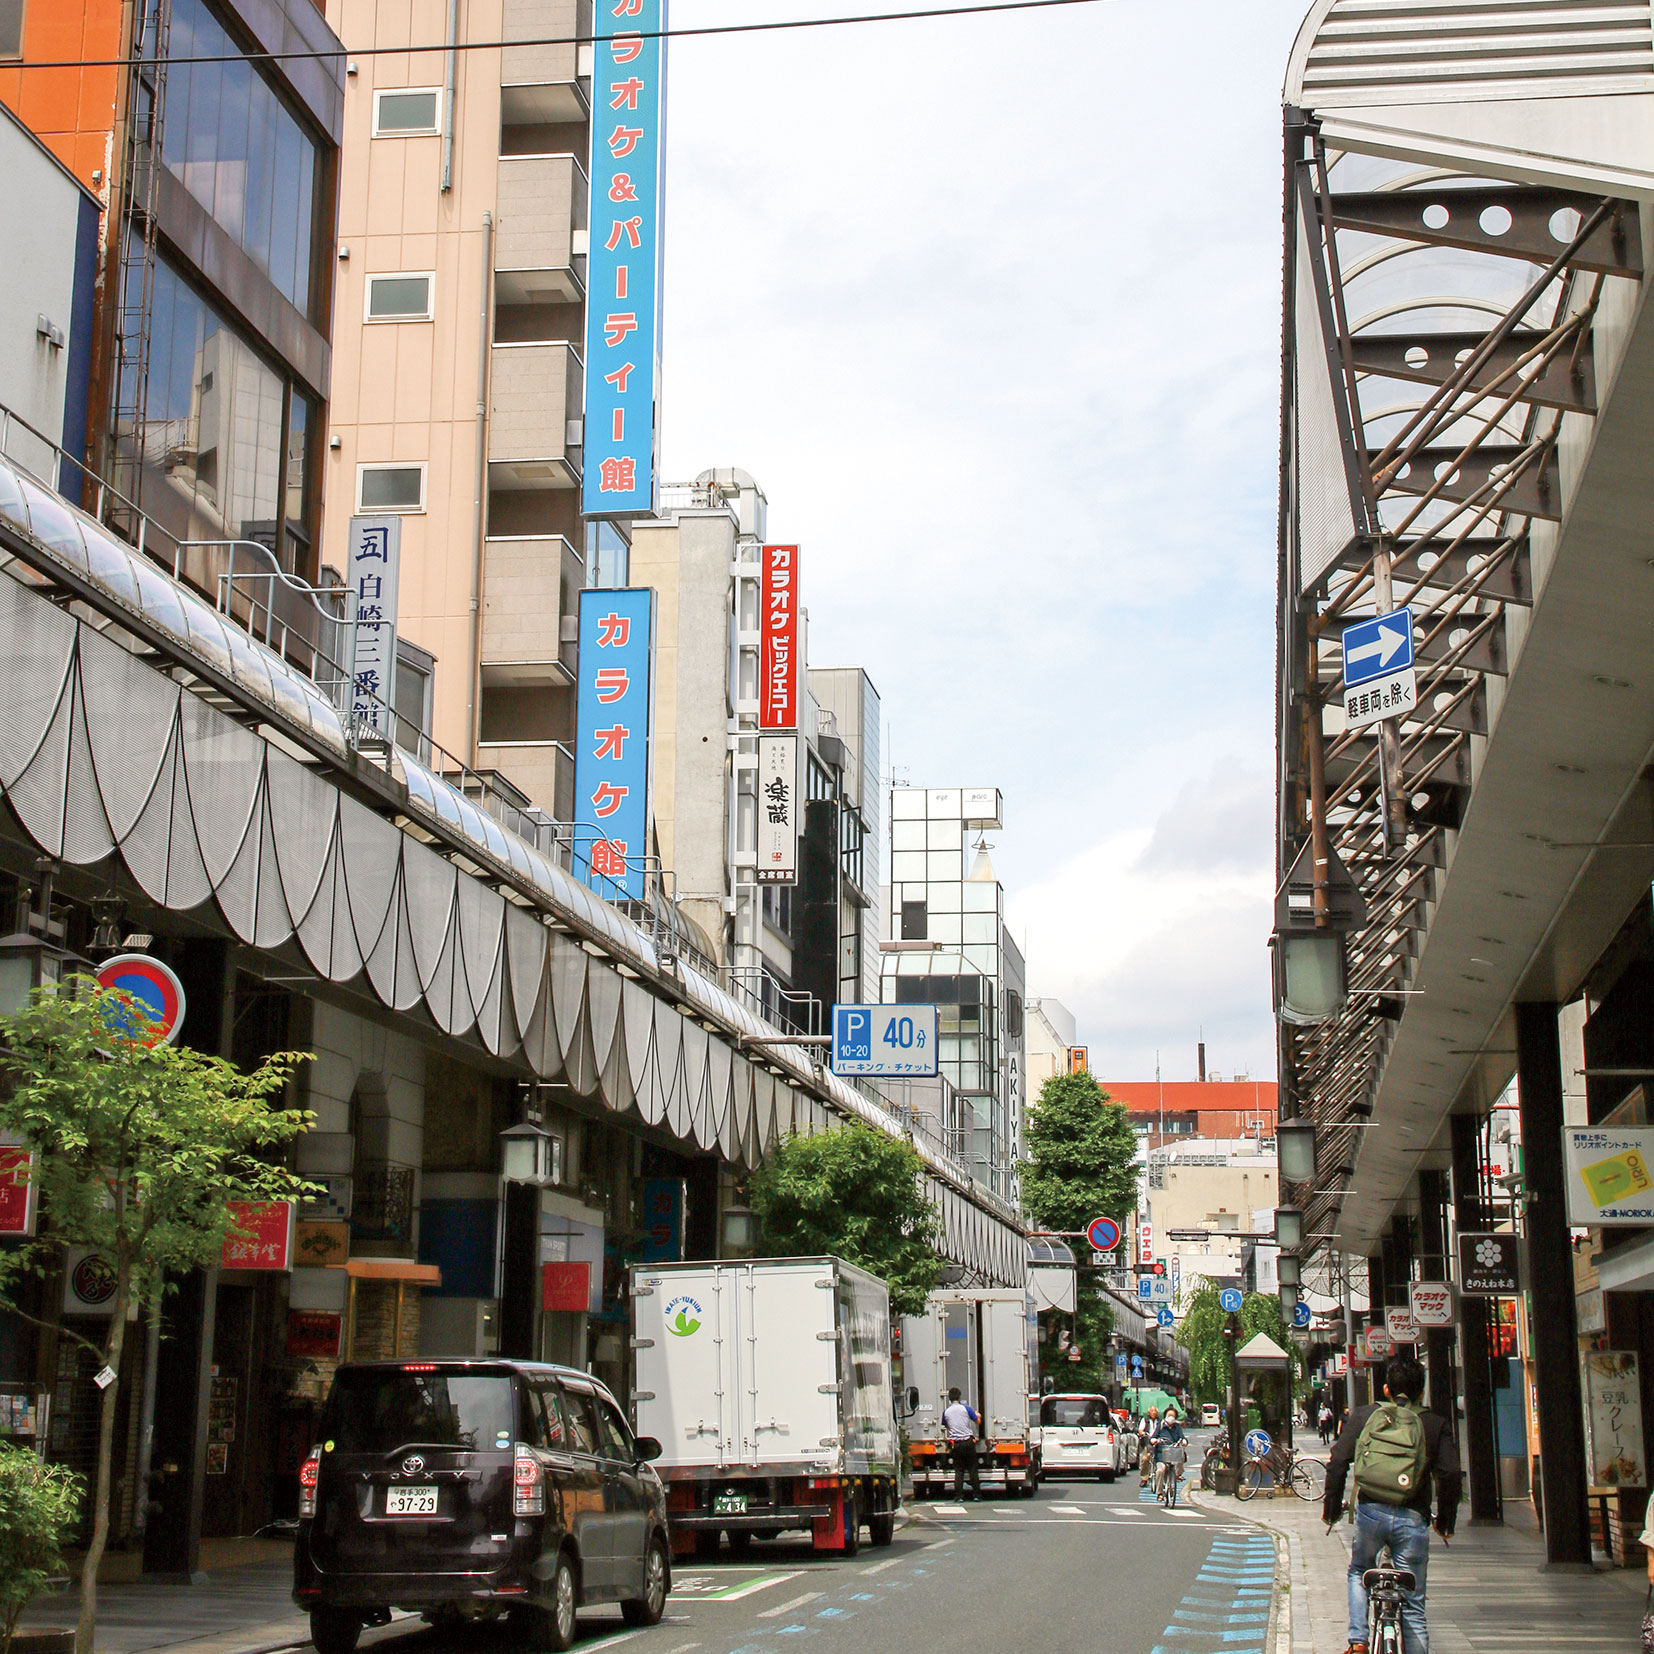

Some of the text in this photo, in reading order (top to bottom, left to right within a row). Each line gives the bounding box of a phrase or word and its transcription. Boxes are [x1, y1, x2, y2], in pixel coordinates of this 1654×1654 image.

[770, 548, 791, 724] カラオケ ビッグエコー
[1347, 681, 1411, 719] 軽車両を除く
[847, 1013, 865, 1042] P
[882, 1016, 927, 1049] 40分
[840, 1045, 868, 1057] 10-20
[837, 1063, 932, 1072] パーキング・チケット
[1413, 1292, 1449, 1301] カラオケ
[1419, 1302, 1444, 1311] マック
[398, 1497, 435, 1511] 97-29
